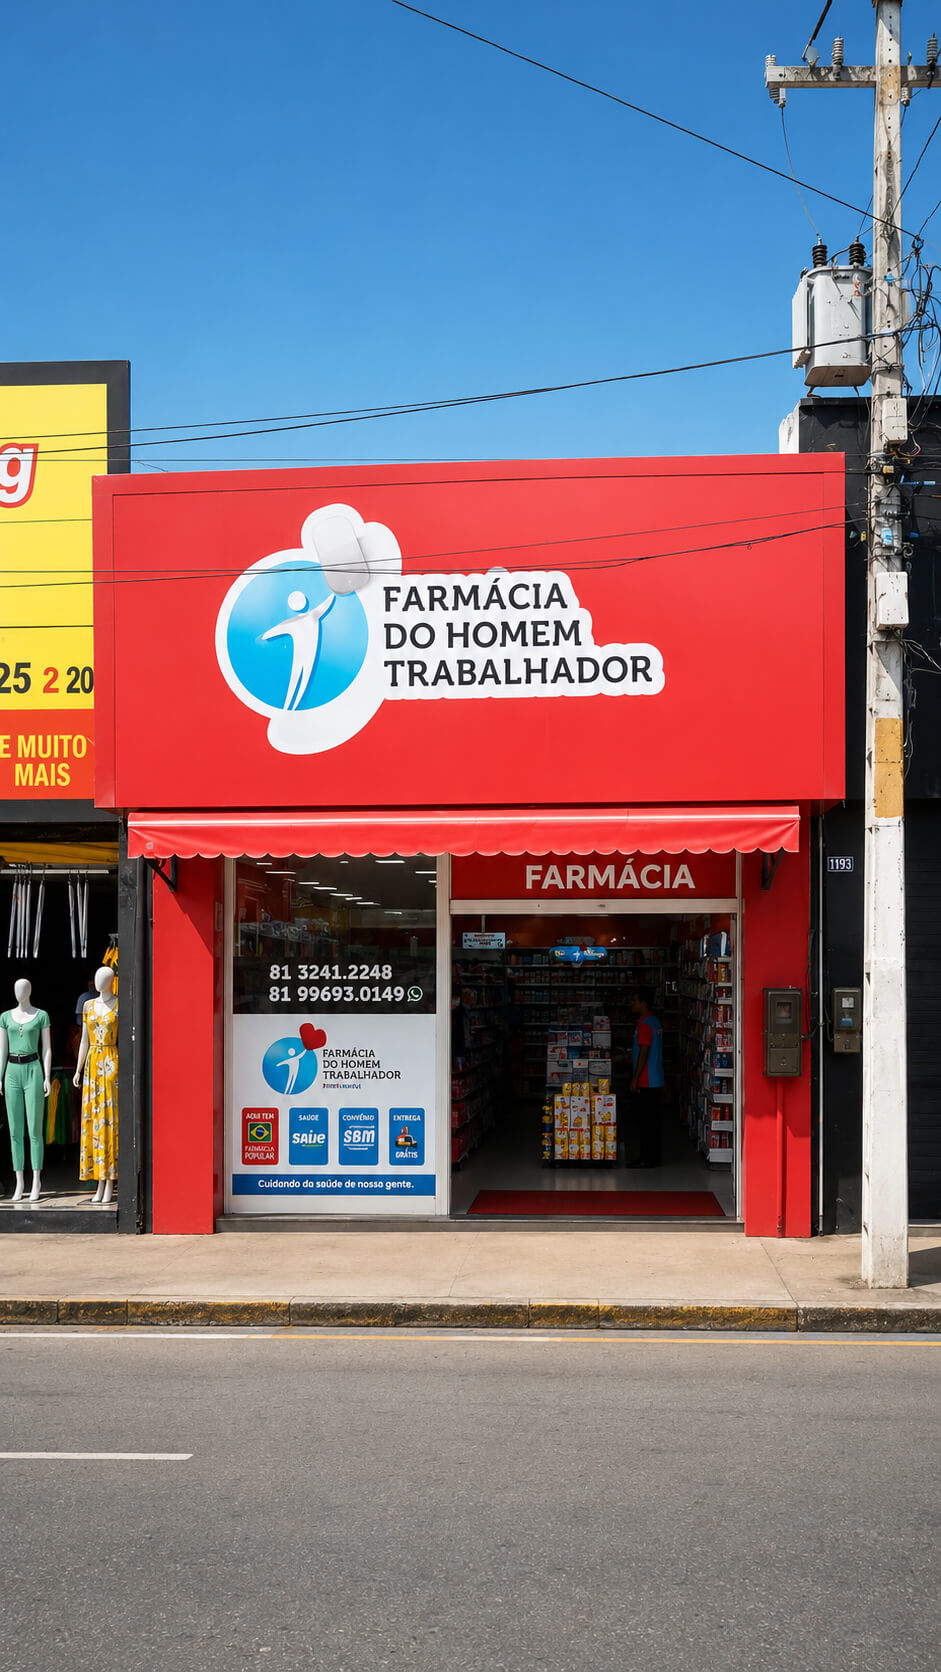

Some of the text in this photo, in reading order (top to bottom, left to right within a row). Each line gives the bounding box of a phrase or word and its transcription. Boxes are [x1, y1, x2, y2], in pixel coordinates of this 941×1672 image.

[383, 577, 568, 612] FARMÁCIA
[384, 620, 582, 650] DO HOMEM
[43, 667, 59, 694] 2
[384, 655, 653, 687] TRABALHADOR
[17, 734, 87, 759] MUITO
[15, 762, 71, 787] MAIS
[525, 858, 696, 890] FARMÁCIA
[829, 858, 853, 870] 1193
[269, 964, 393, 980] 81 3241.2248
[268, 986, 405, 1002] 81 99693.0149
[322, 1046, 376, 1058] FARMÁCIA
[323, 1060, 381, 1069] DO HOMEM
[323, 1070, 401, 1080] TRABALHADOR
[343, 1129, 375, 1143] SBM
